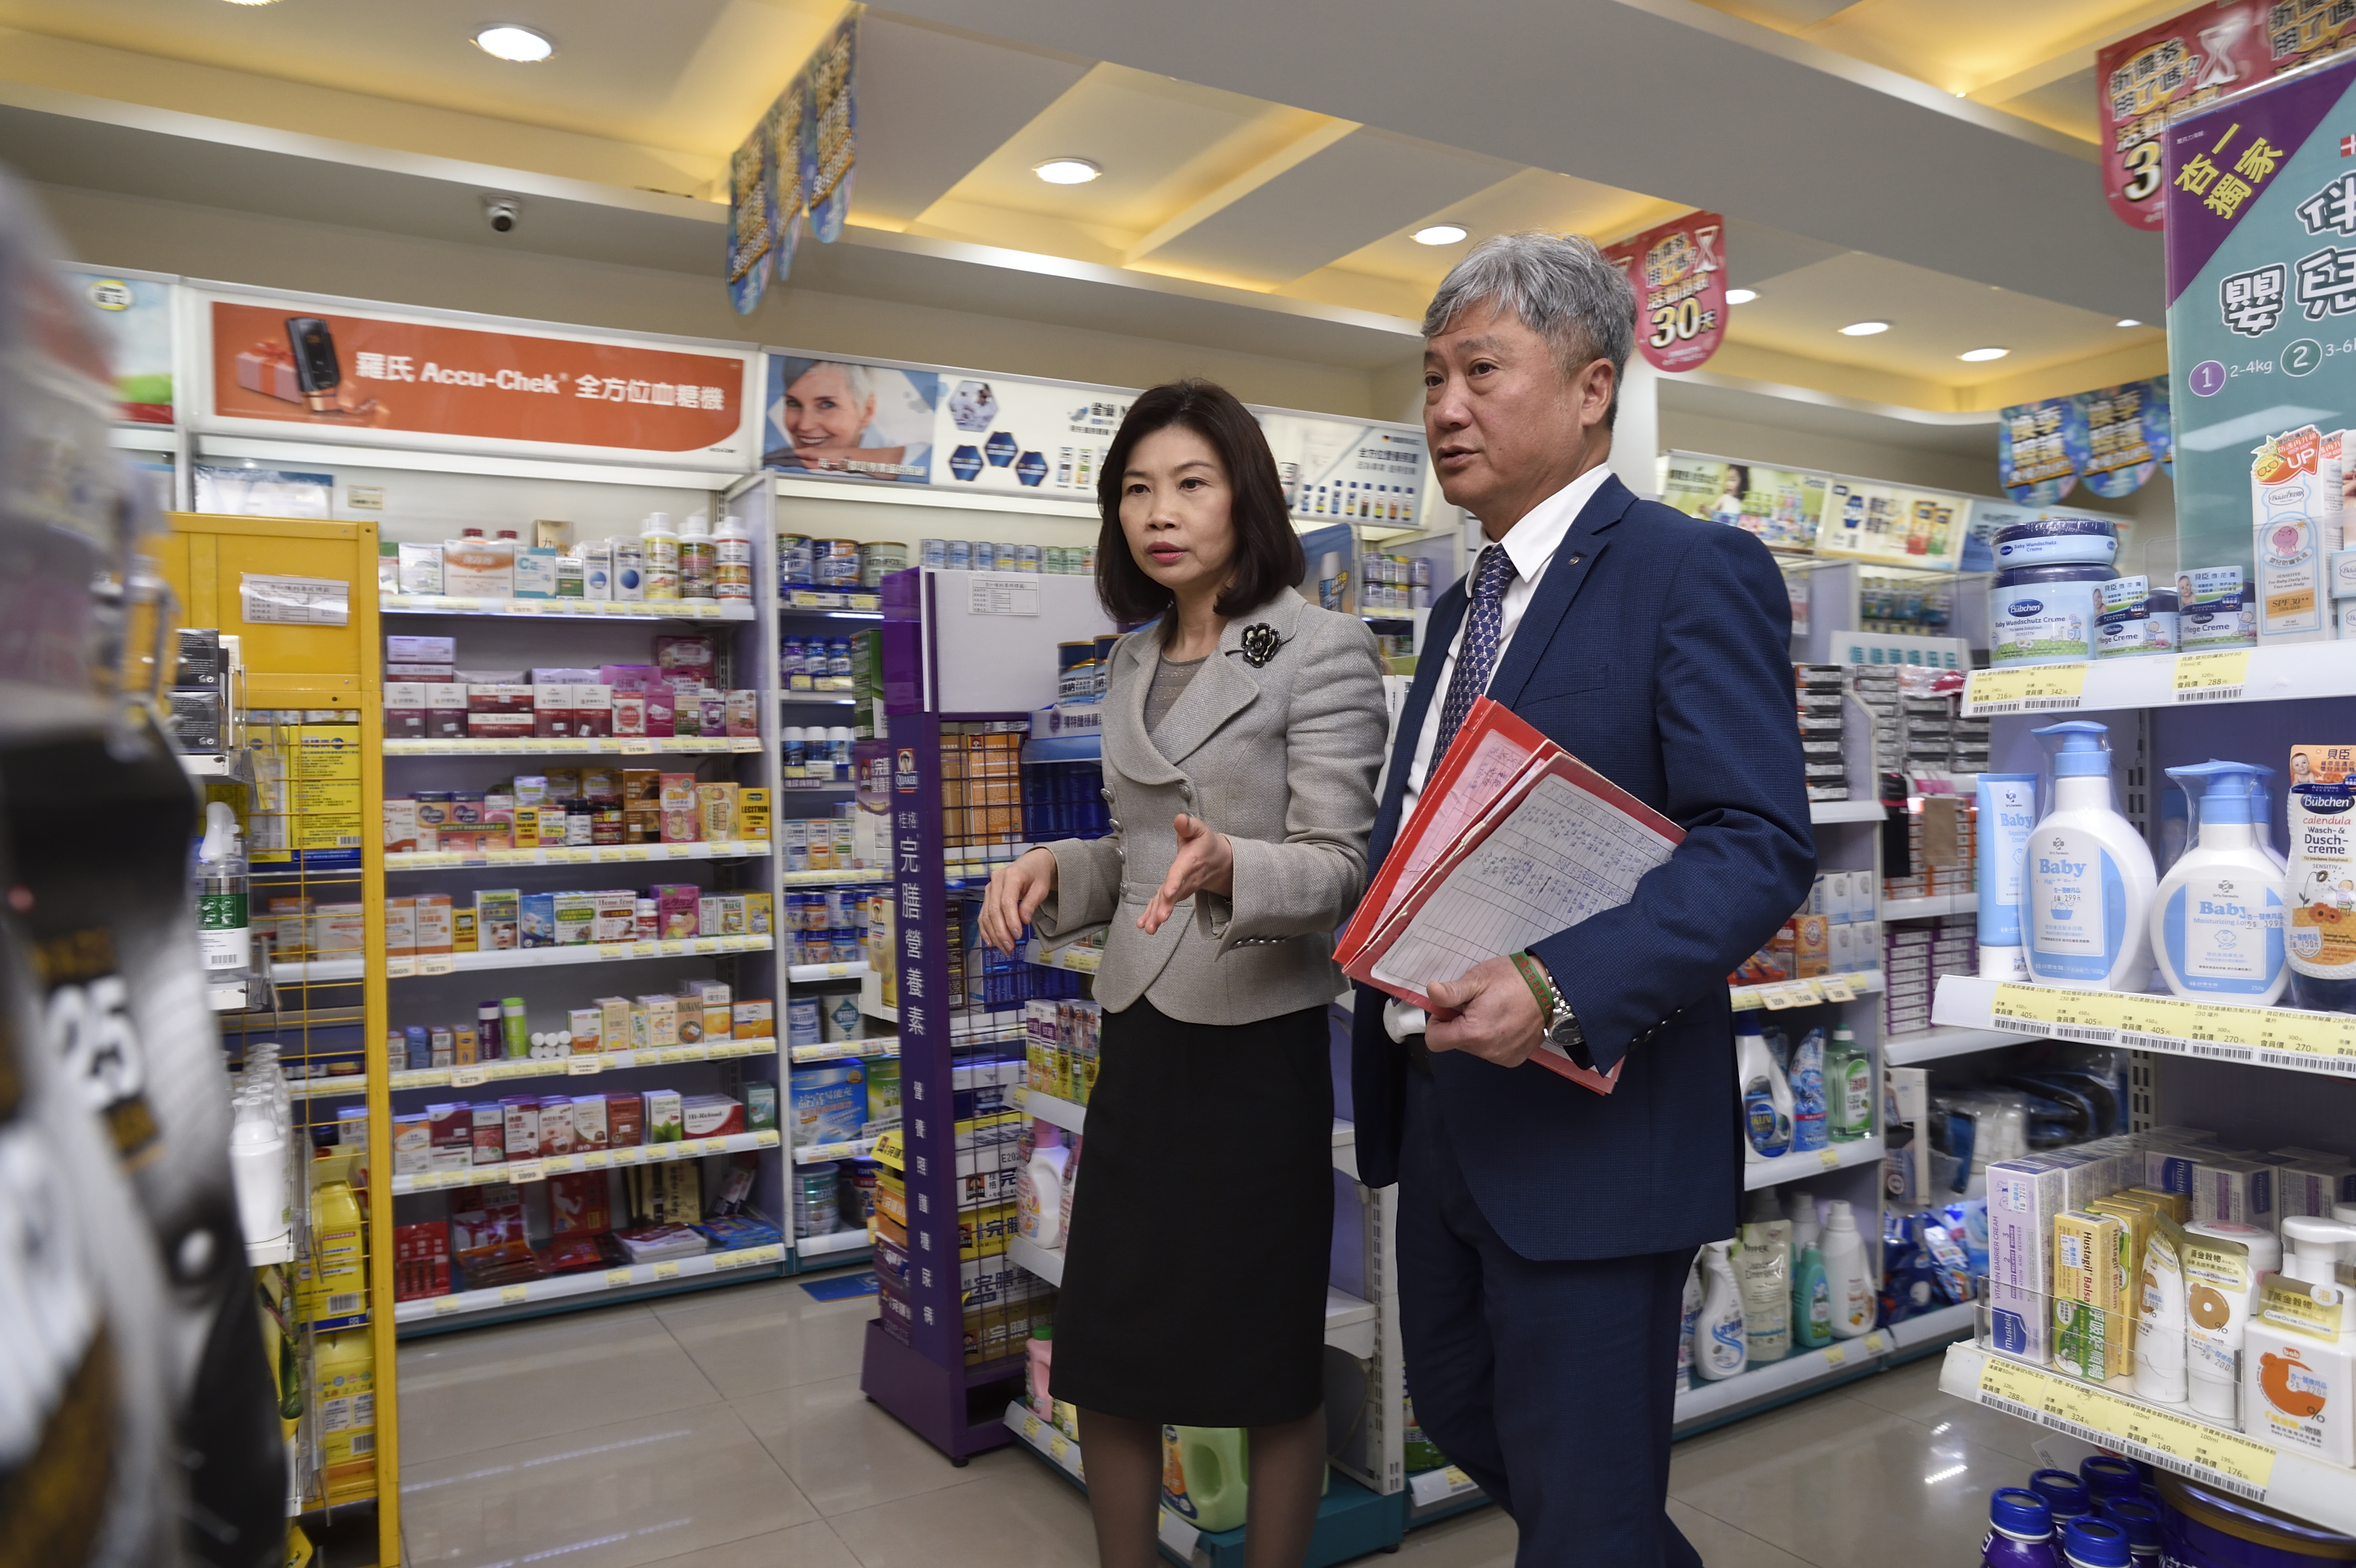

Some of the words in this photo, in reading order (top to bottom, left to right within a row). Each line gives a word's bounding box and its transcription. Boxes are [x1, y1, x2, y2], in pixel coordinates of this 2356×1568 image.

[2174, 123, 2239, 196] 杏一
[2203, 137, 2284, 219] 獨家
[2325, 340, 2356, 357] 3-6
[2230, 359, 2272, 378] 2-4kg
[356, 352, 415, 381] 羅氏
[575, 374, 725, 411] 全方位血糖機
[2263, 445, 2275, 455] NEW
[2287, 448, 2315, 468] UP
[2269, 552, 2309, 566] 嬰兒防曬乳液
[2105, 582, 2117, 592] 貝臣
[2009, 604, 2040, 613] Bübchen
[2272, 599, 2290, 608] SPF
[2006, 618, 2041, 626] Wundschutz
[2184, 626, 2200, 634] Pflege
[2327, 749, 2350, 760] 貝臣
[895, 774, 918, 786] QUAKER
[2303, 795, 2349, 807] Bübchen
[898, 811, 918, 829] 桂格
[1999, 813, 2032, 828] Baby
[2303, 815, 2351, 825] calendula
[2304, 834, 2349, 845] Dusch-
[2307, 845, 2345, 854] creme
[2039, 859, 2087, 878] Baby
[2193, 918, 2235, 926] Moisturizing
[900, 837, 927, 1036] 完膳營養素
[2289, 933, 2318, 941] 杏一醫療用品
[1995, 1008, 2013, 1016] 會員價
[2122, 1023, 2142, 1032] 會員價
[2192, 1033, 2214, 1041] 會員價
[2260, 1040, 2284, 1049] 會員價
[688, 1111, 722, 1120] Hi-Reload
[2082, 1231, 2093, 1272] Hustagil
[2190, 1249, 2221, 1263] 黃金穀物
[2084, 1276, 2093, 1303] Balsa
[2272, 1291, 2312, 1309] 黃金穀物
[2005, 1313, 2013, 1350] mustela
[2291, 1372, 2327, 1389] 杏一醫療用品
[1982, 1383, 2001, 1394] 會員價
[2044, 1404, 2063, 1416] 會員價
[2133, 1411, 2150, 1420] 100ml
[2127, 1432, 2148, 1444] 會員價
[2200, 1433, 2219, 1443] 100ml
[2194, 1455, 2217, 1468] 會員價
